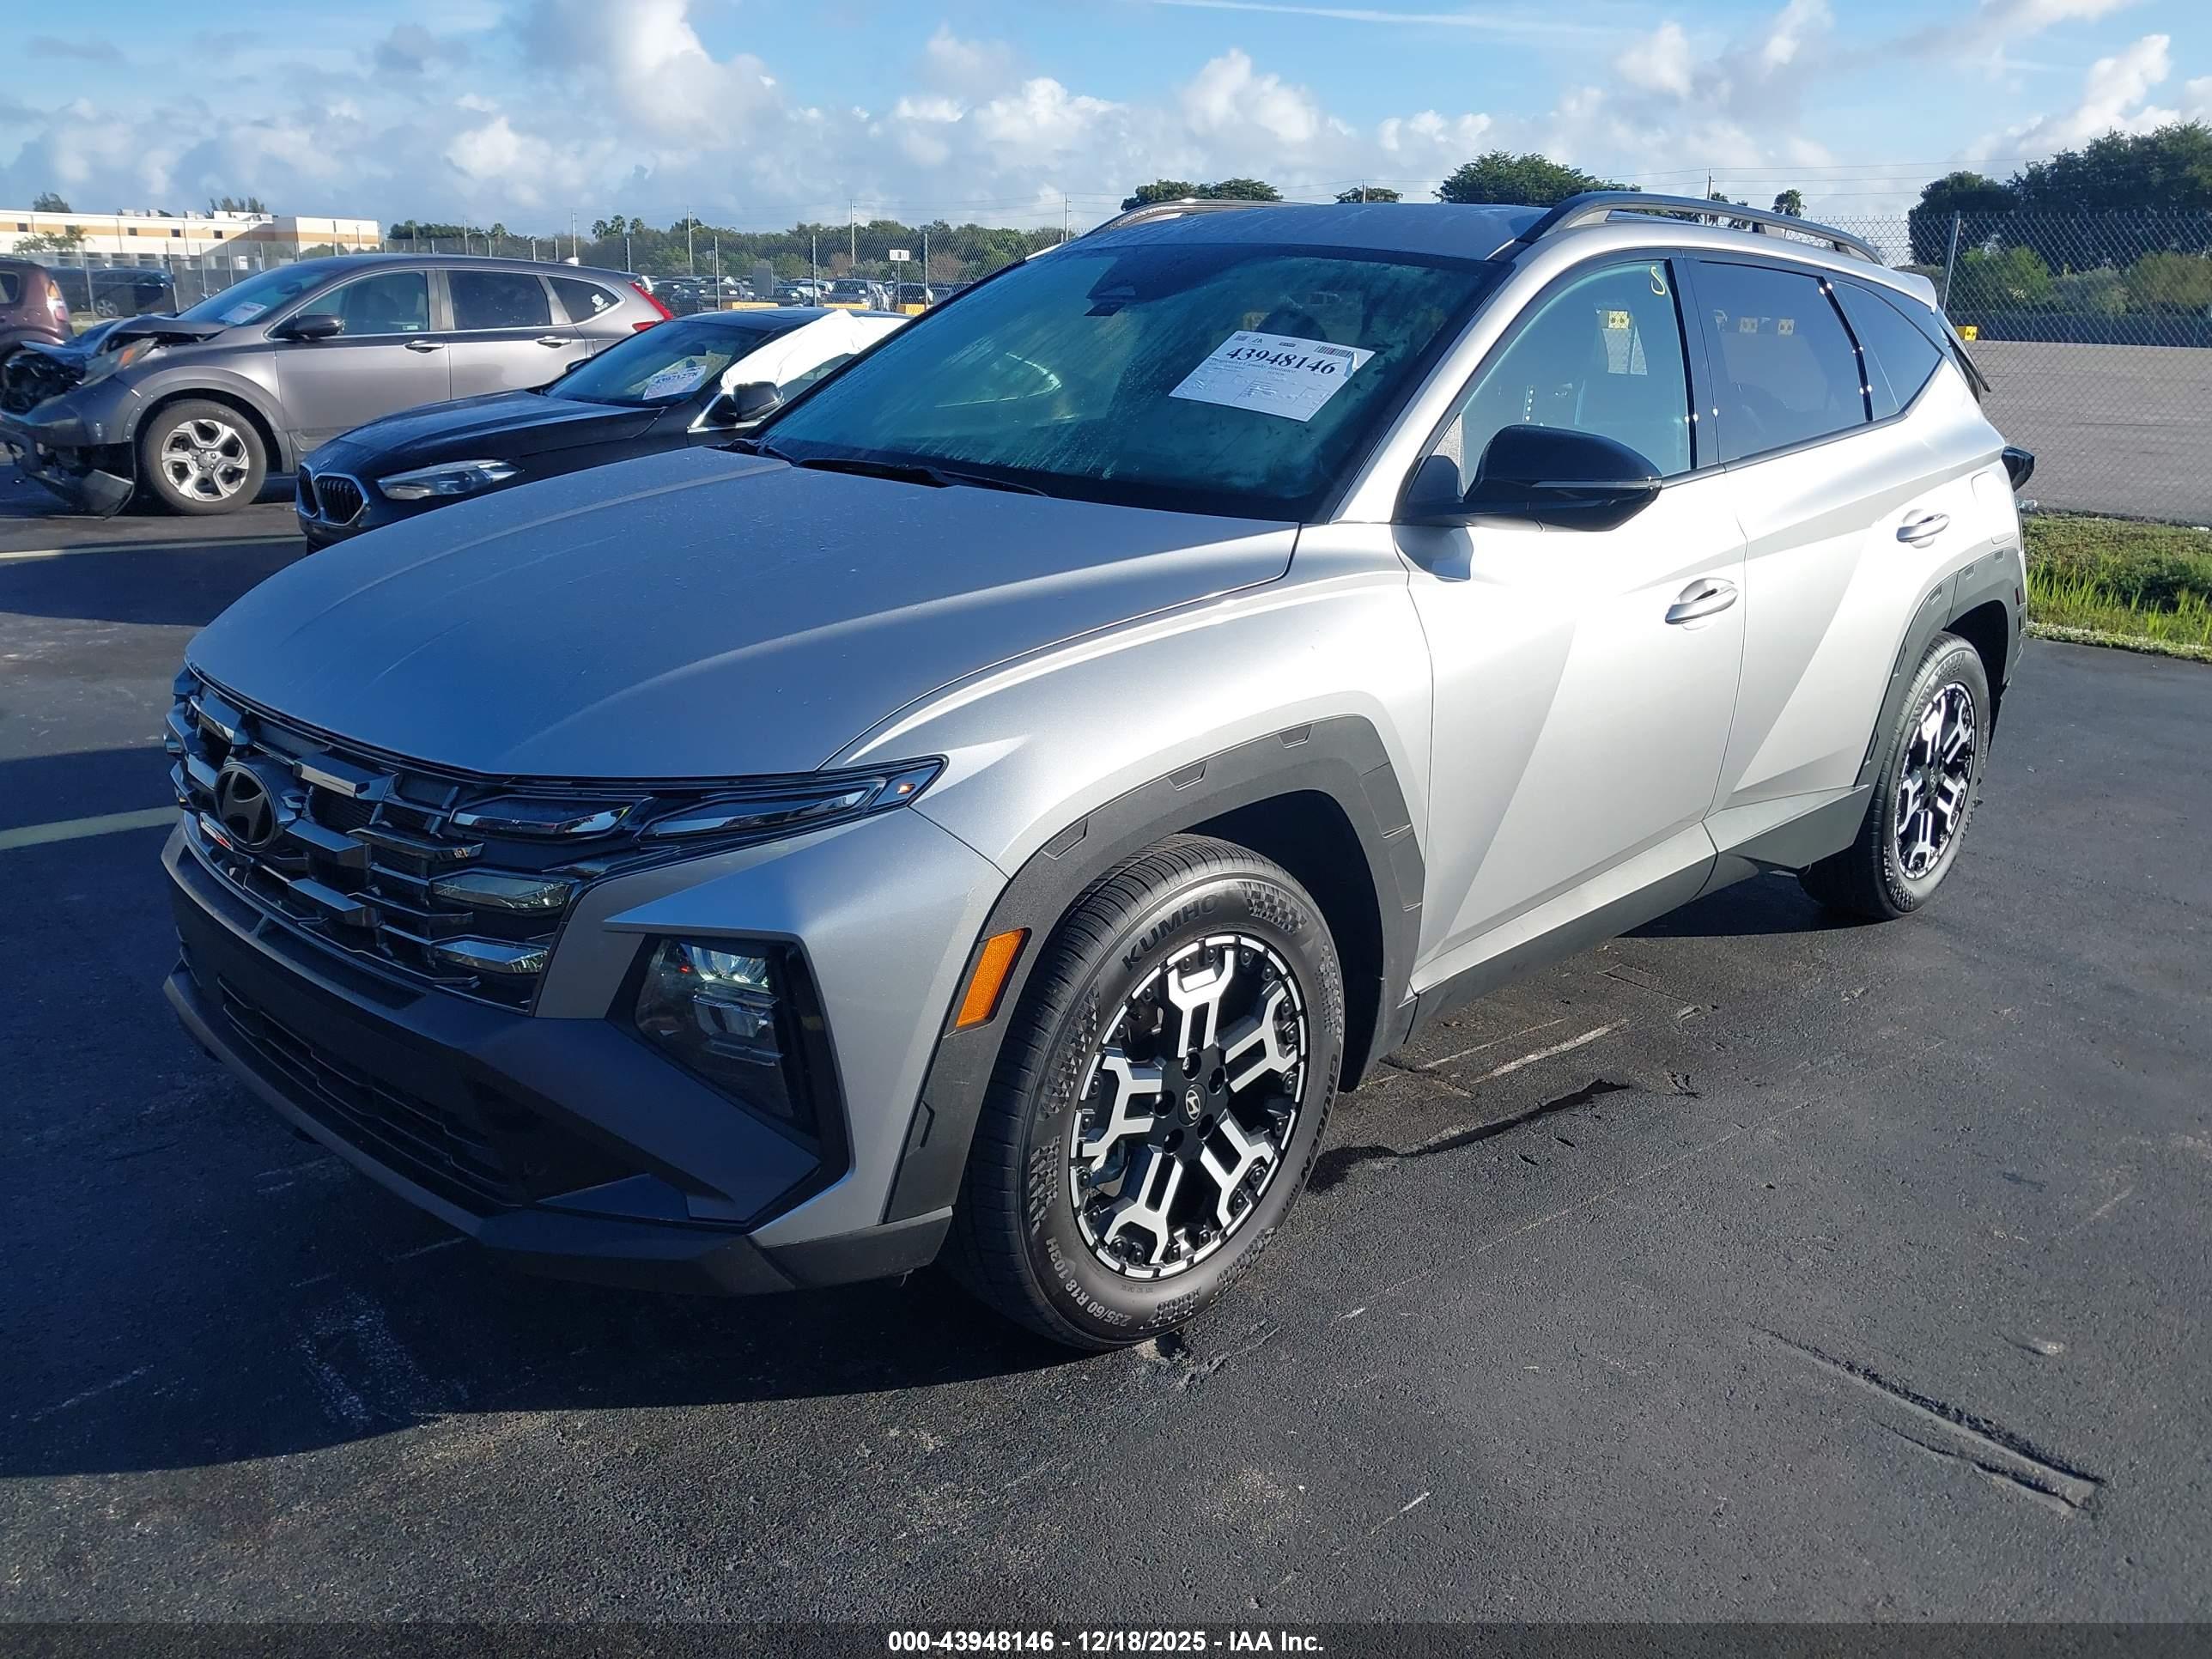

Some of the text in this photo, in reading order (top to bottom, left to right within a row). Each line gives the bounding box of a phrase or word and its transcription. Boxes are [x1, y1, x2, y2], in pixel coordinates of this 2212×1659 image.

[1226, 347, 1340, 375] 43948146
[1121, 894, 1219, 972] KUMHO
[1046, 1237, 1133, 1327] 235/60 R18 103H
